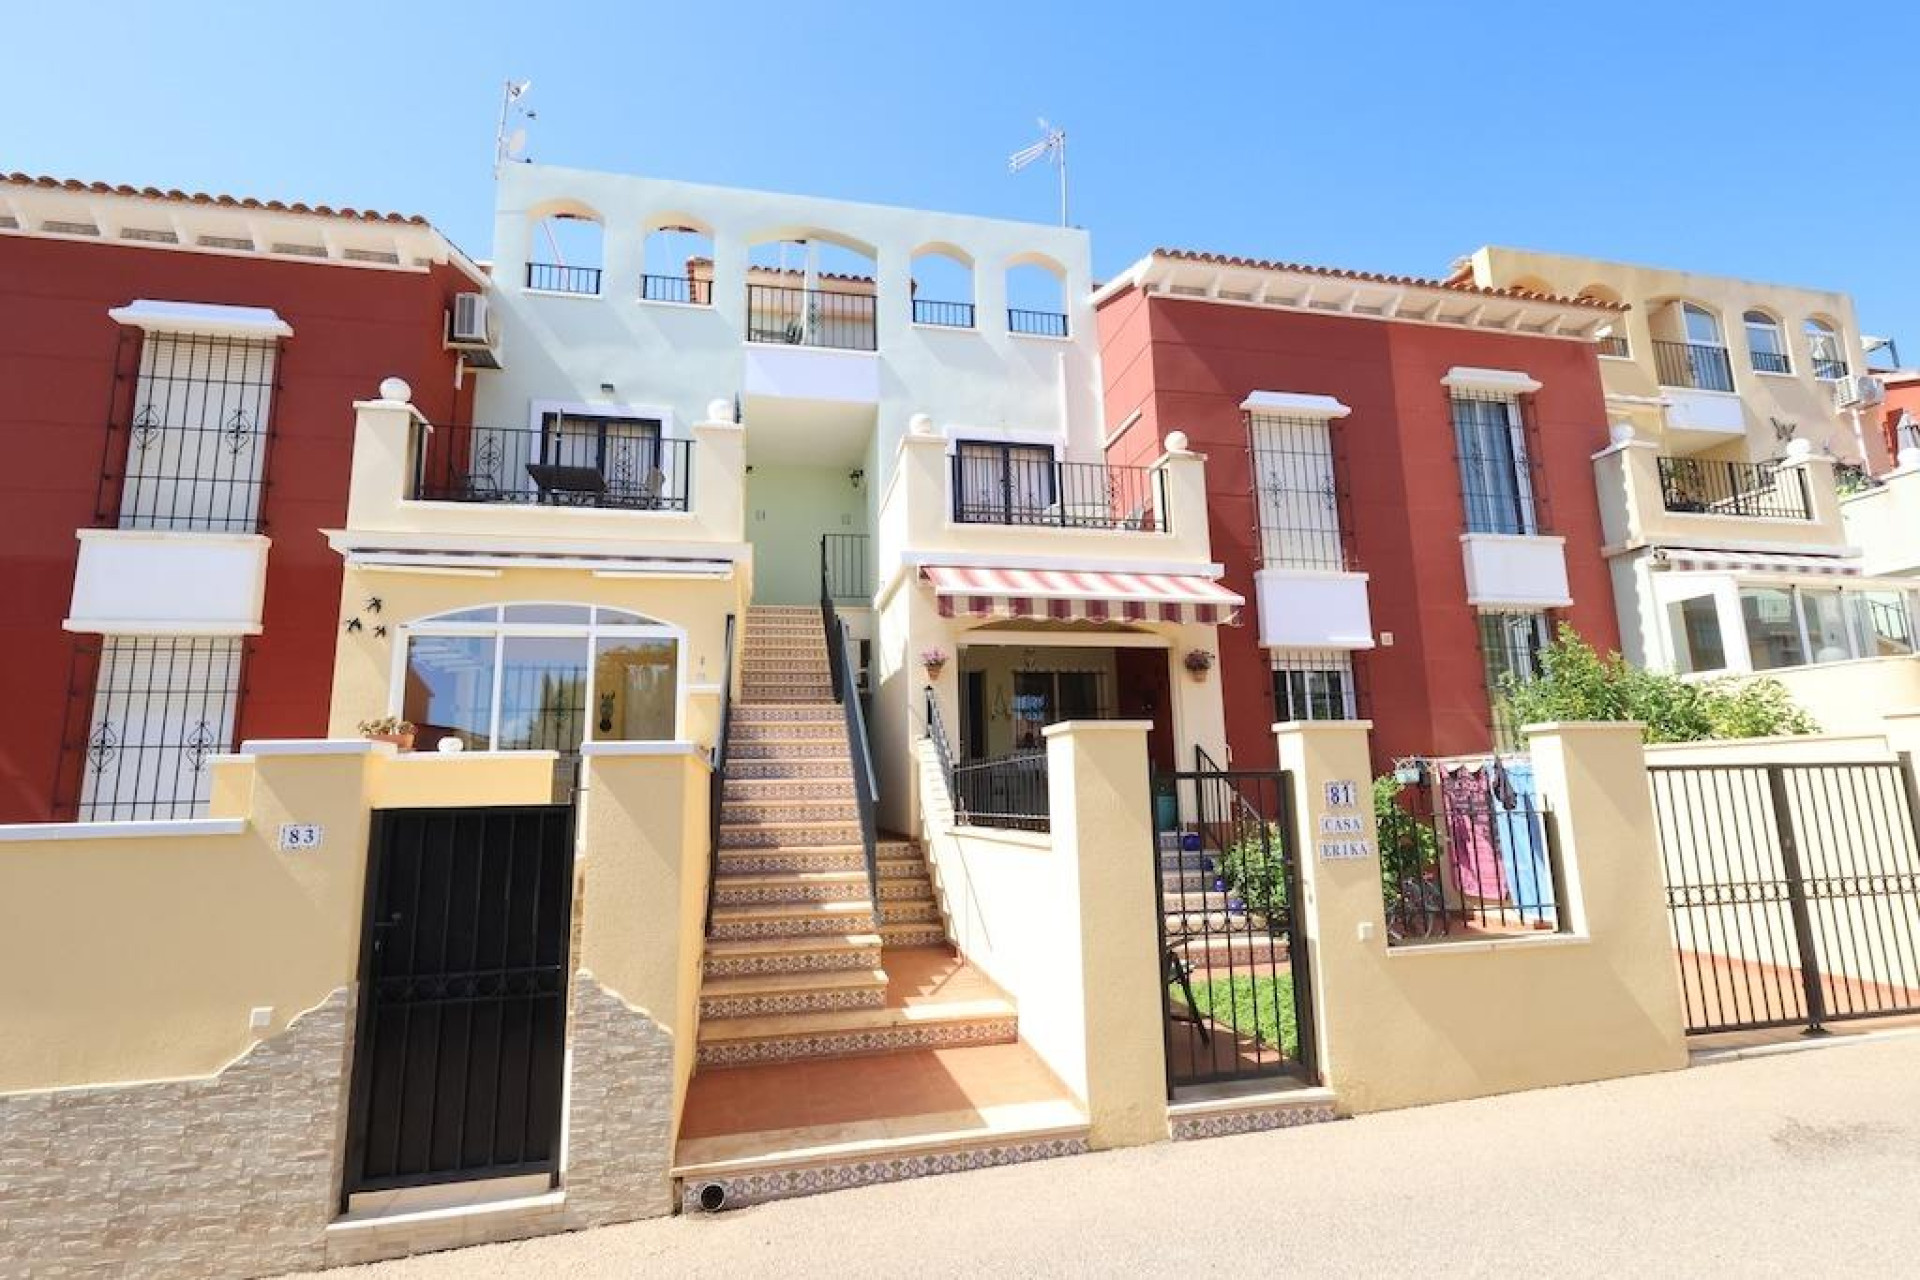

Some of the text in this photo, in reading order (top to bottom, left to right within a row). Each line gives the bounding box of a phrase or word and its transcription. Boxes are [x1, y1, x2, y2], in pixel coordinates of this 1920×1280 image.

[1330, 784, 1349, 804] 81
[1324, 818, 1361, 831] CASA
[289, 829, 314, 844] 83
[1322, 843, 1368, 857] ERIKA
